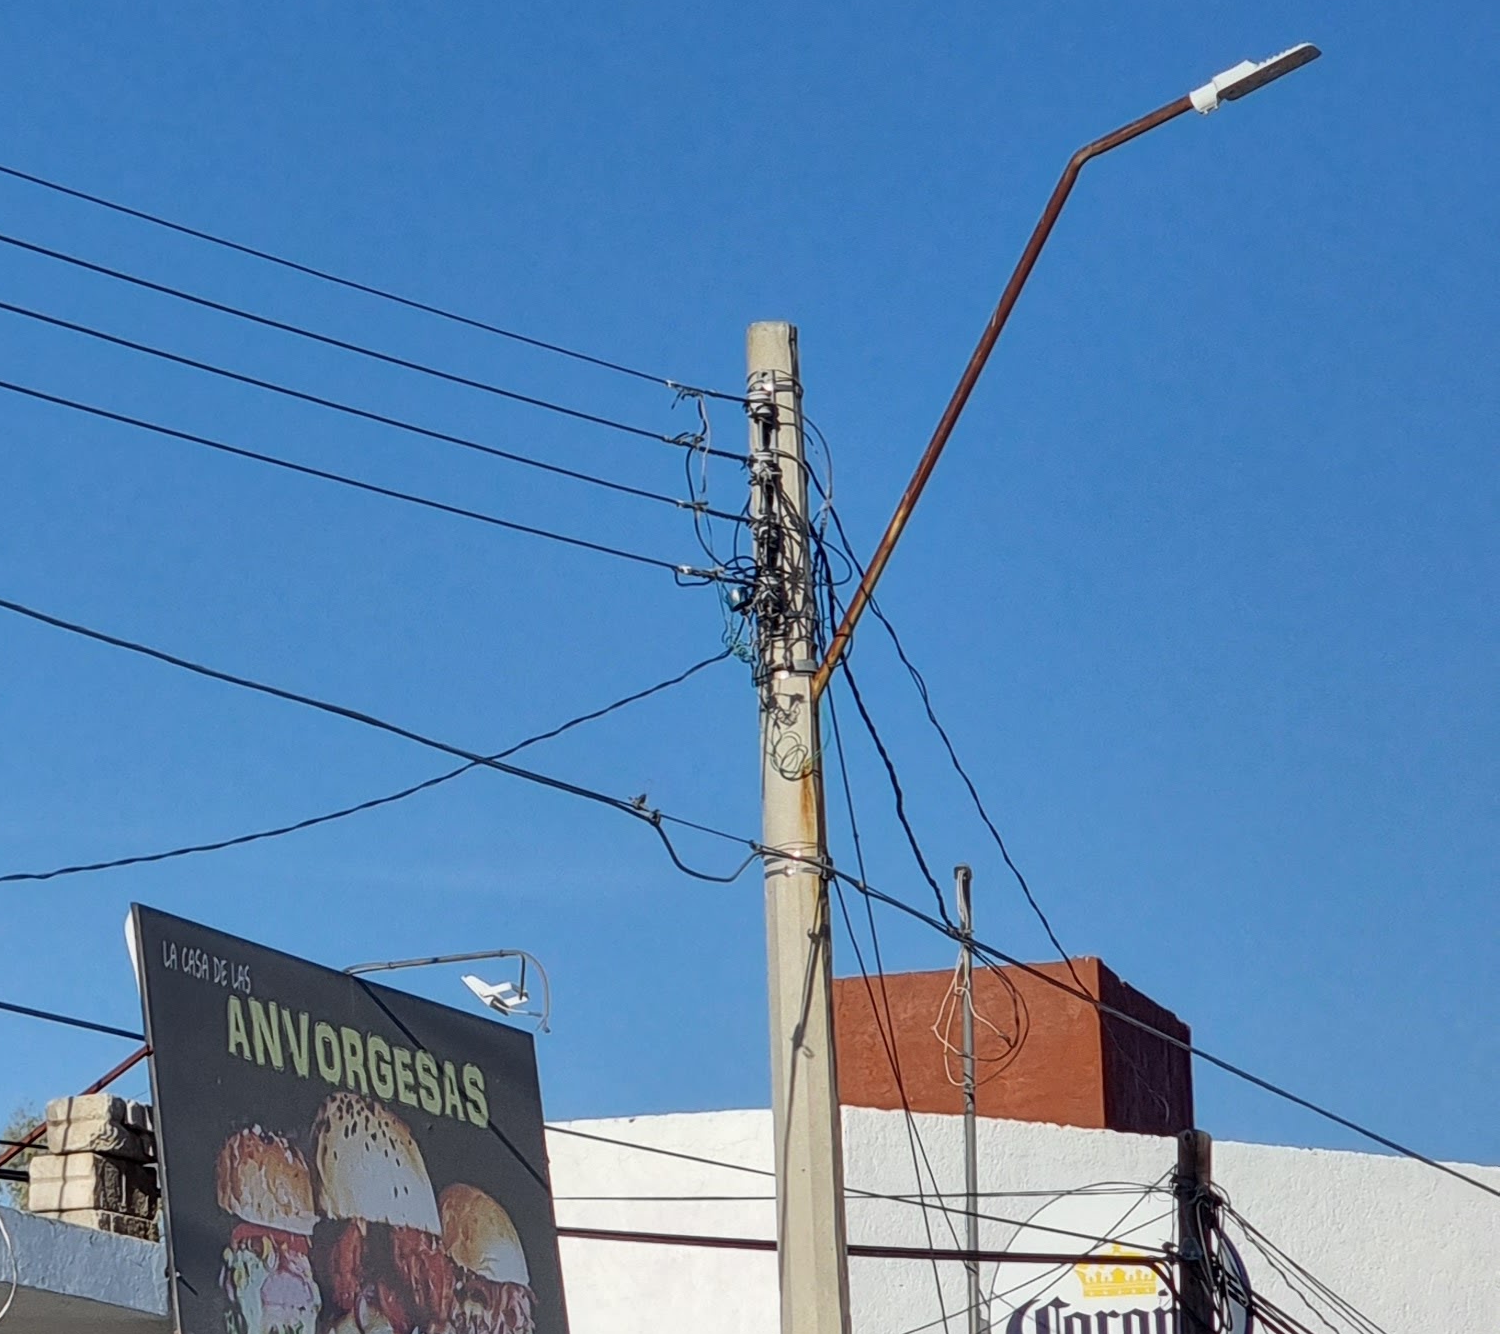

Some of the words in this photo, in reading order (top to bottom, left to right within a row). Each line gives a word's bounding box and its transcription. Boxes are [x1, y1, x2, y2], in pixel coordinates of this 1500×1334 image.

[162, 940, 177, 970] LA
[182, 947, 209, 980] CASA
[213, 956, 227, 986] DE
[231, 962, 251, 994] LAS
[227, 995, 490, 1129] ANVORGESAS
